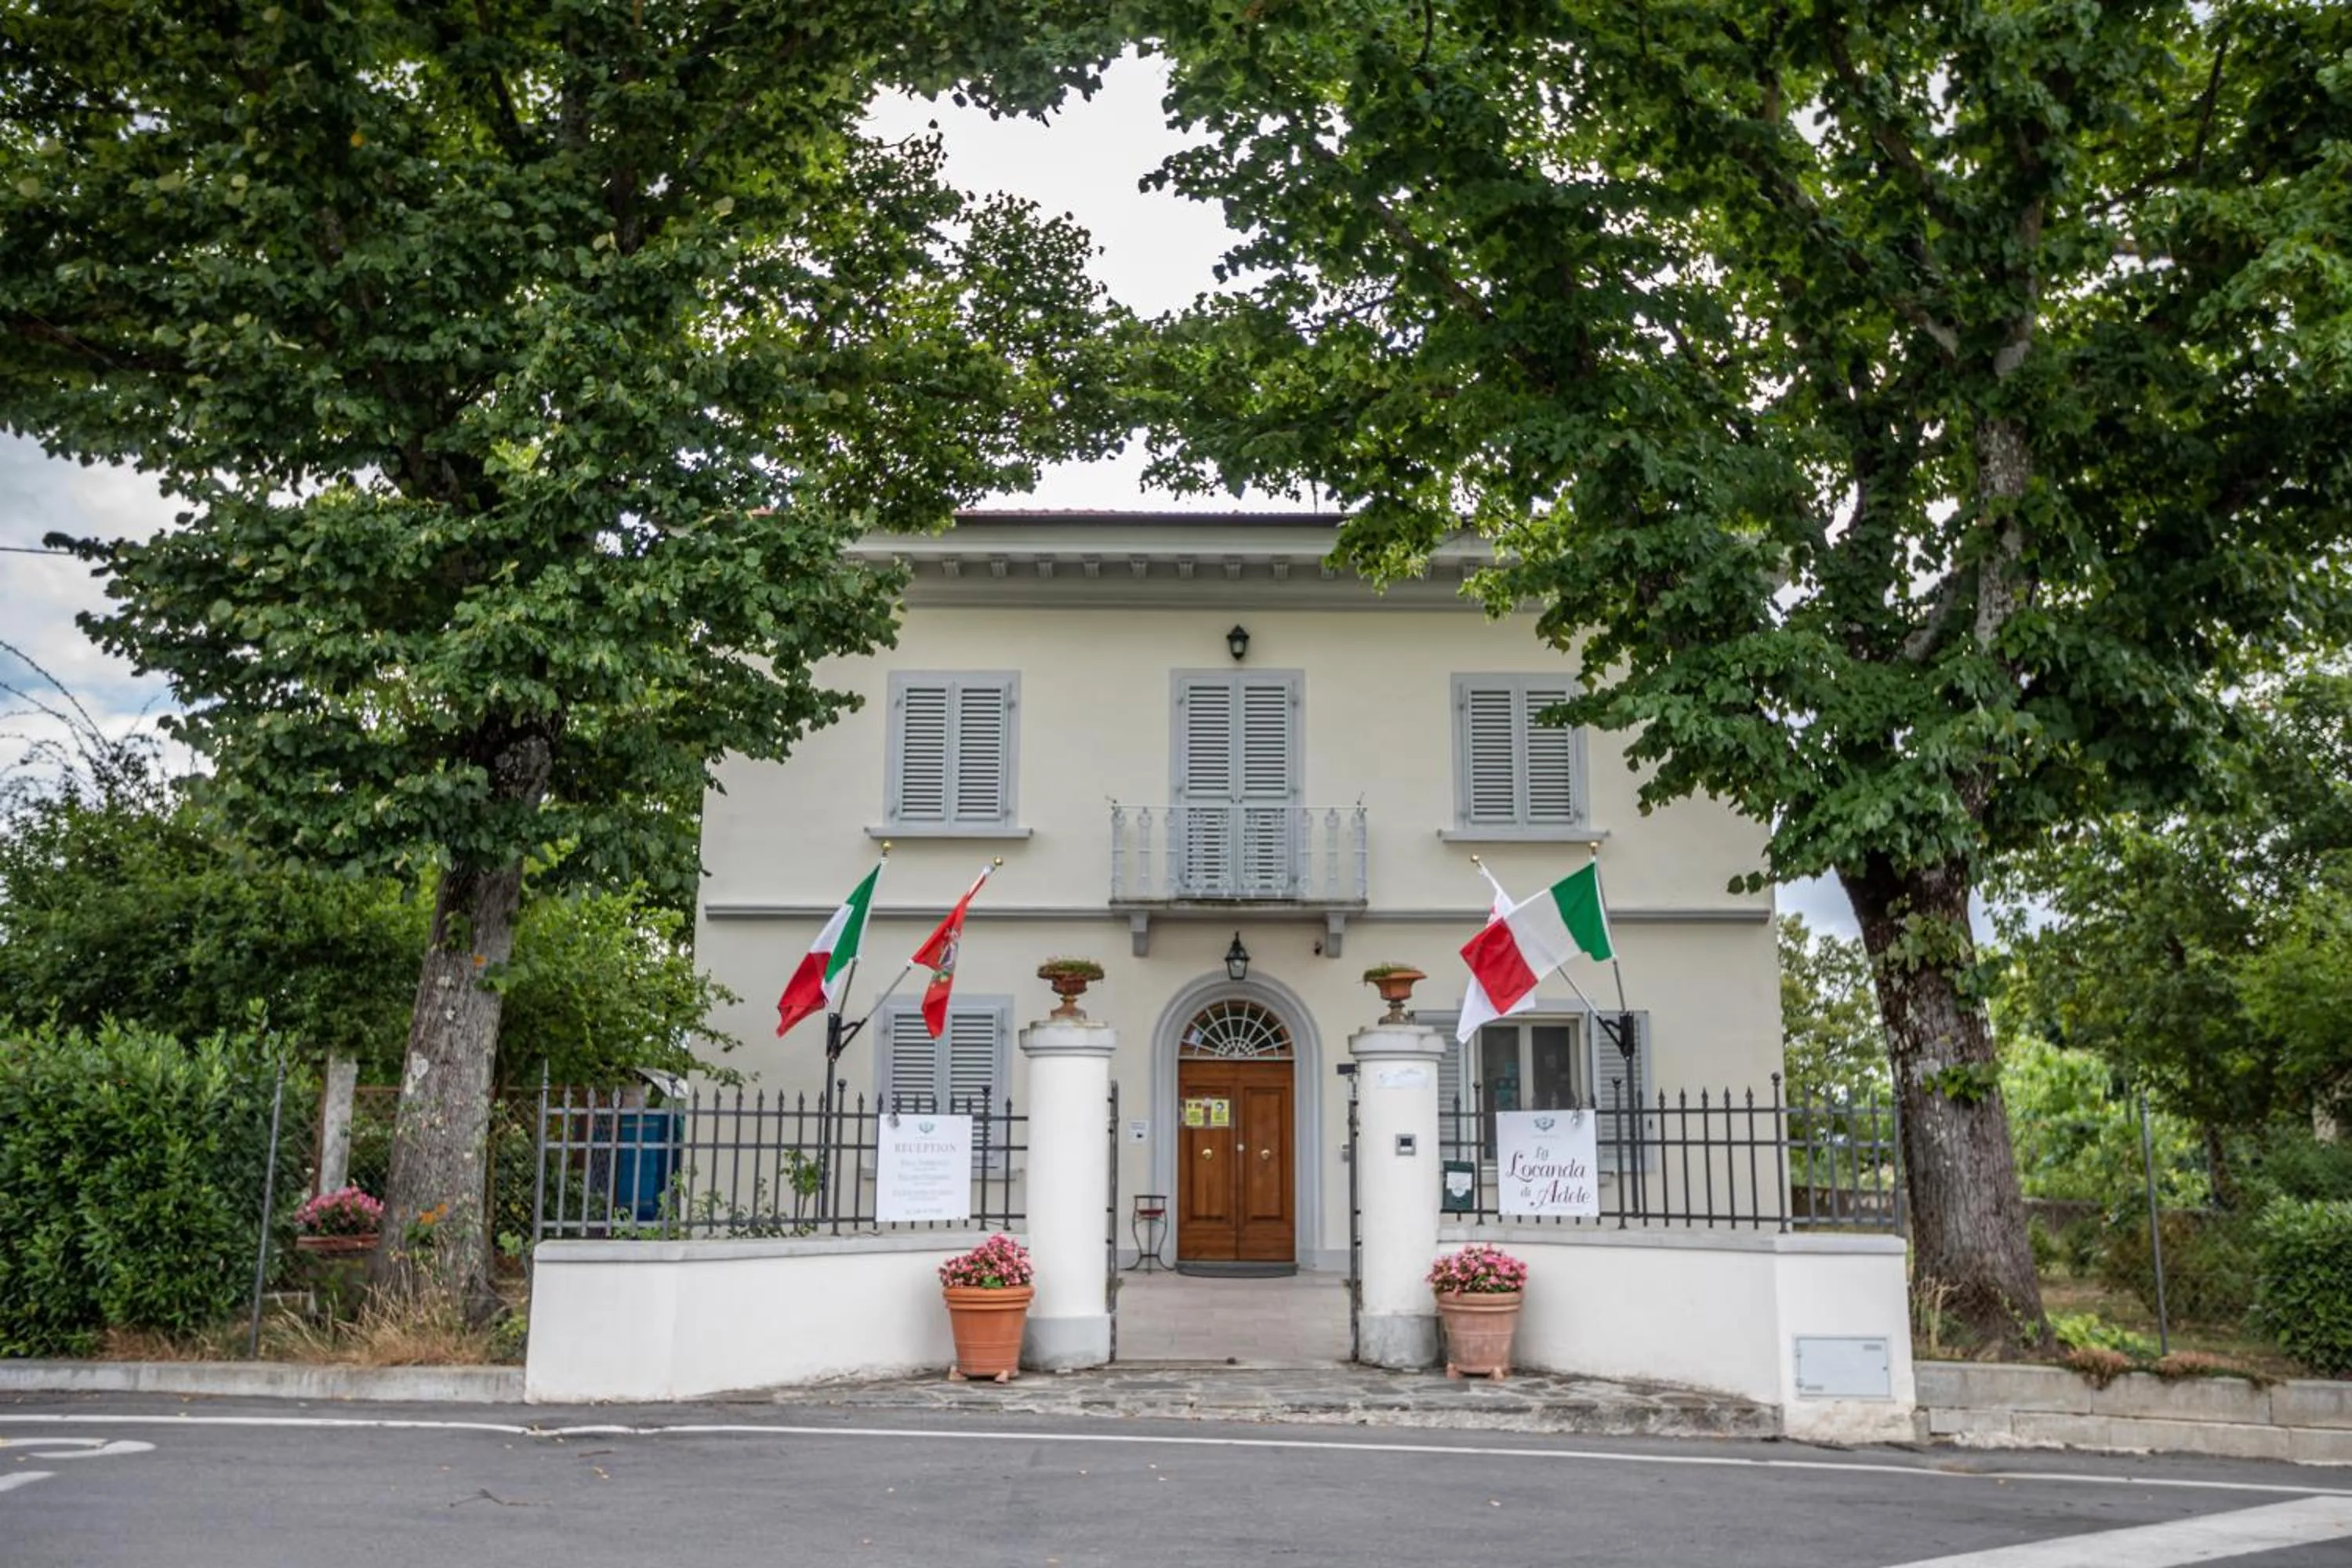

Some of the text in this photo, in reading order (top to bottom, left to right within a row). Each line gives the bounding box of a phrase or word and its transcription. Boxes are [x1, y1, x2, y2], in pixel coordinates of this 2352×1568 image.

[895, 1142, 956, 1153] RECEPTION
[1505, 1150, 1586, 1182] Locanda
[1530, 1179, 1592, 1209] Adele
